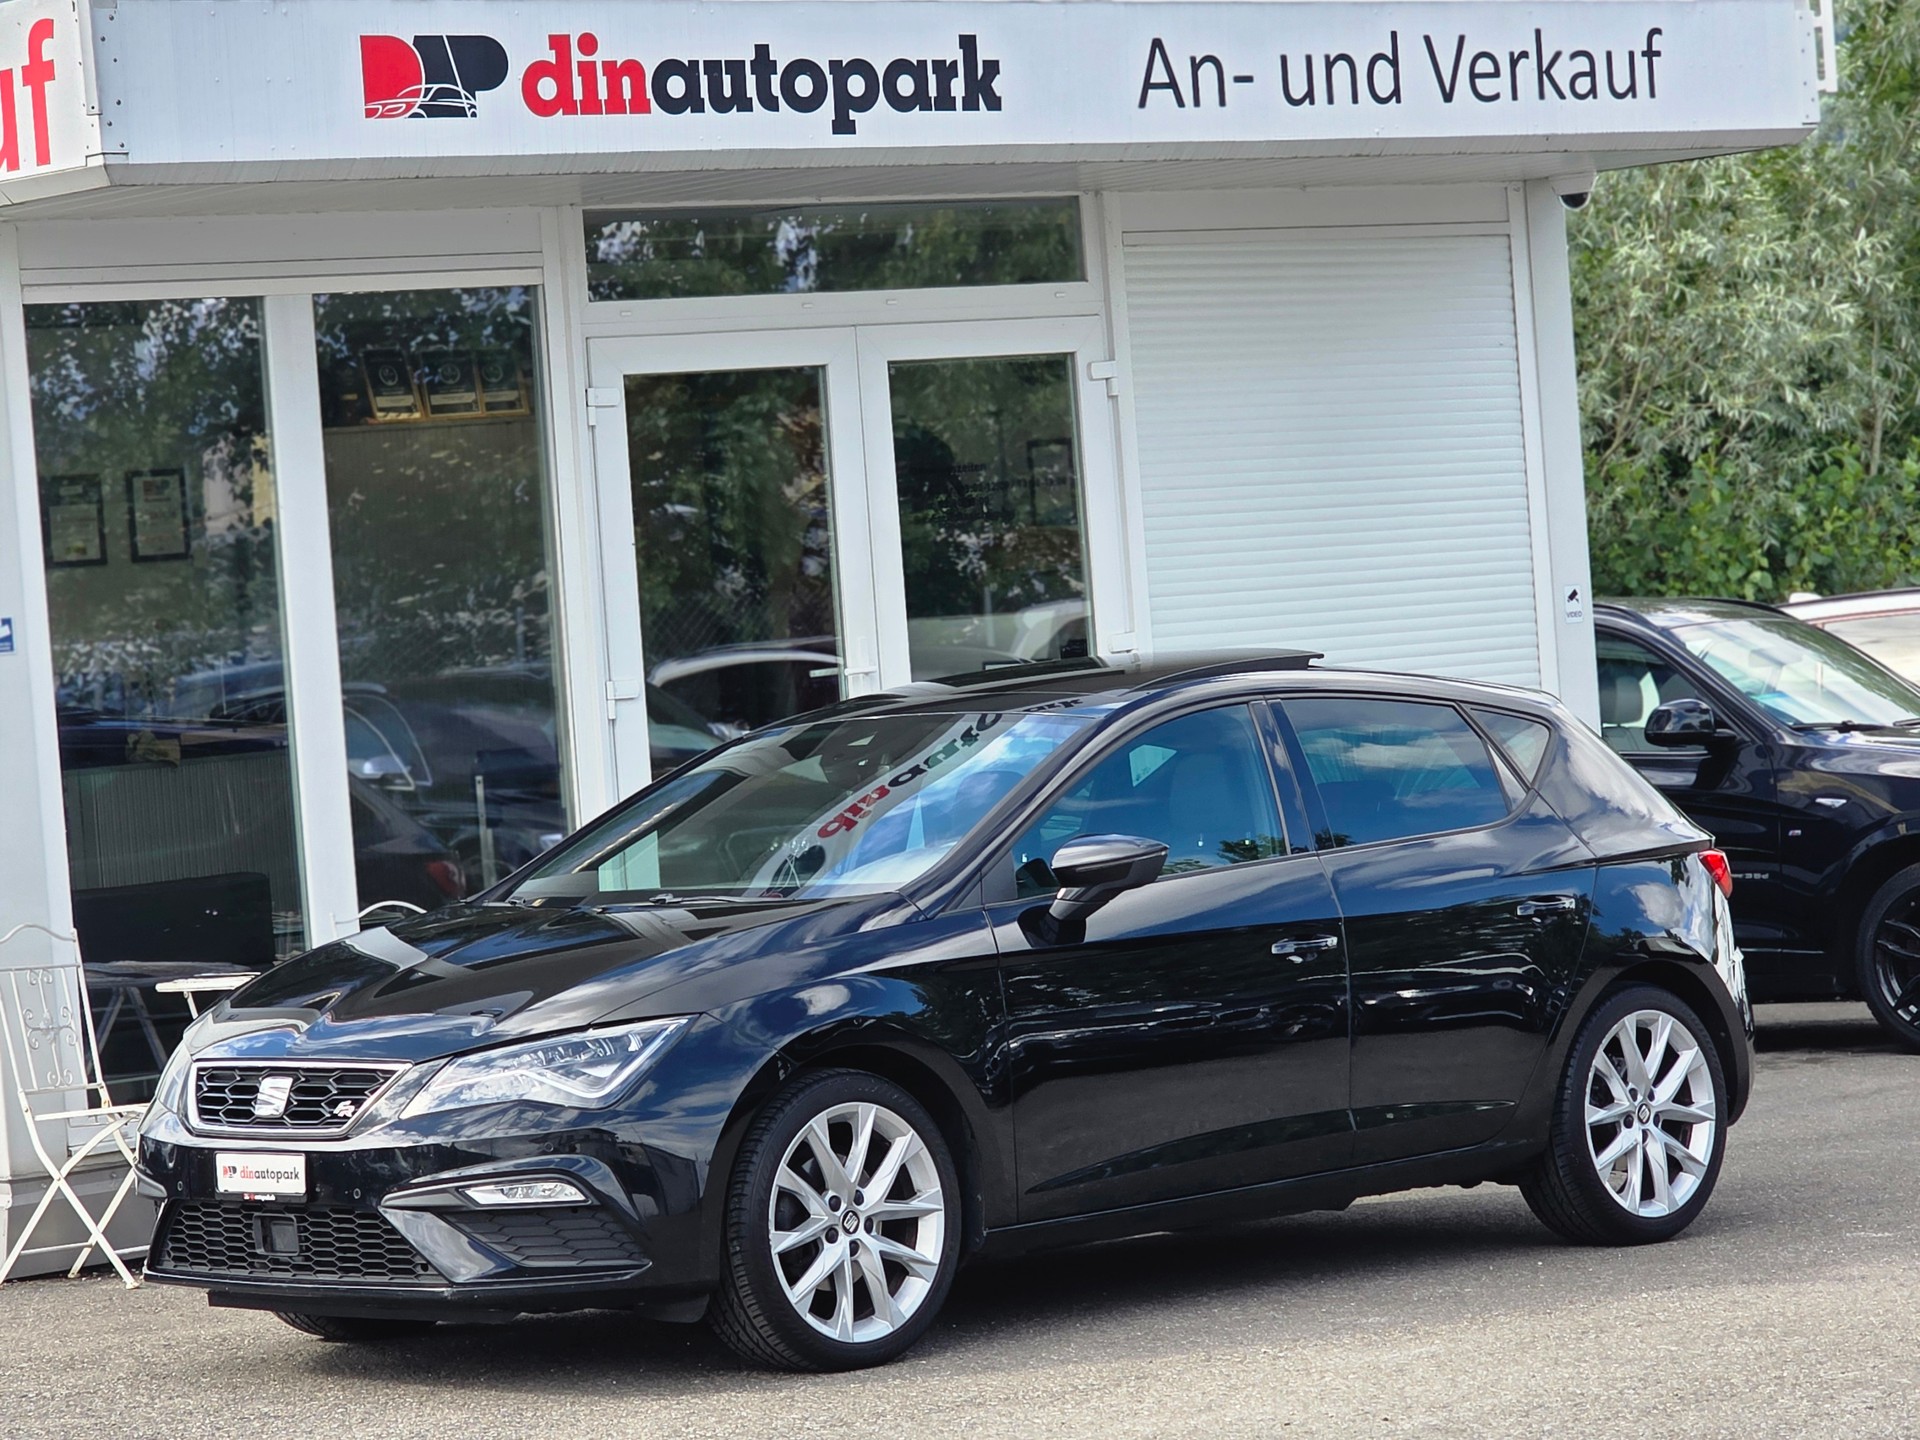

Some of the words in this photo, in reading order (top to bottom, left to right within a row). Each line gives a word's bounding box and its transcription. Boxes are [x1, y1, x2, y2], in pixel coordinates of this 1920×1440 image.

[521, 32, 1002, 135] dinautopark
[1138, 37, 1255, 109] An-
[1280, 30, 1402, 107] und
[1423, 28, 1663, 104] Verkauf
[1567, 610, 1582, 618] VIDEO
[240, 1165, 300, 1184] dinautopark
